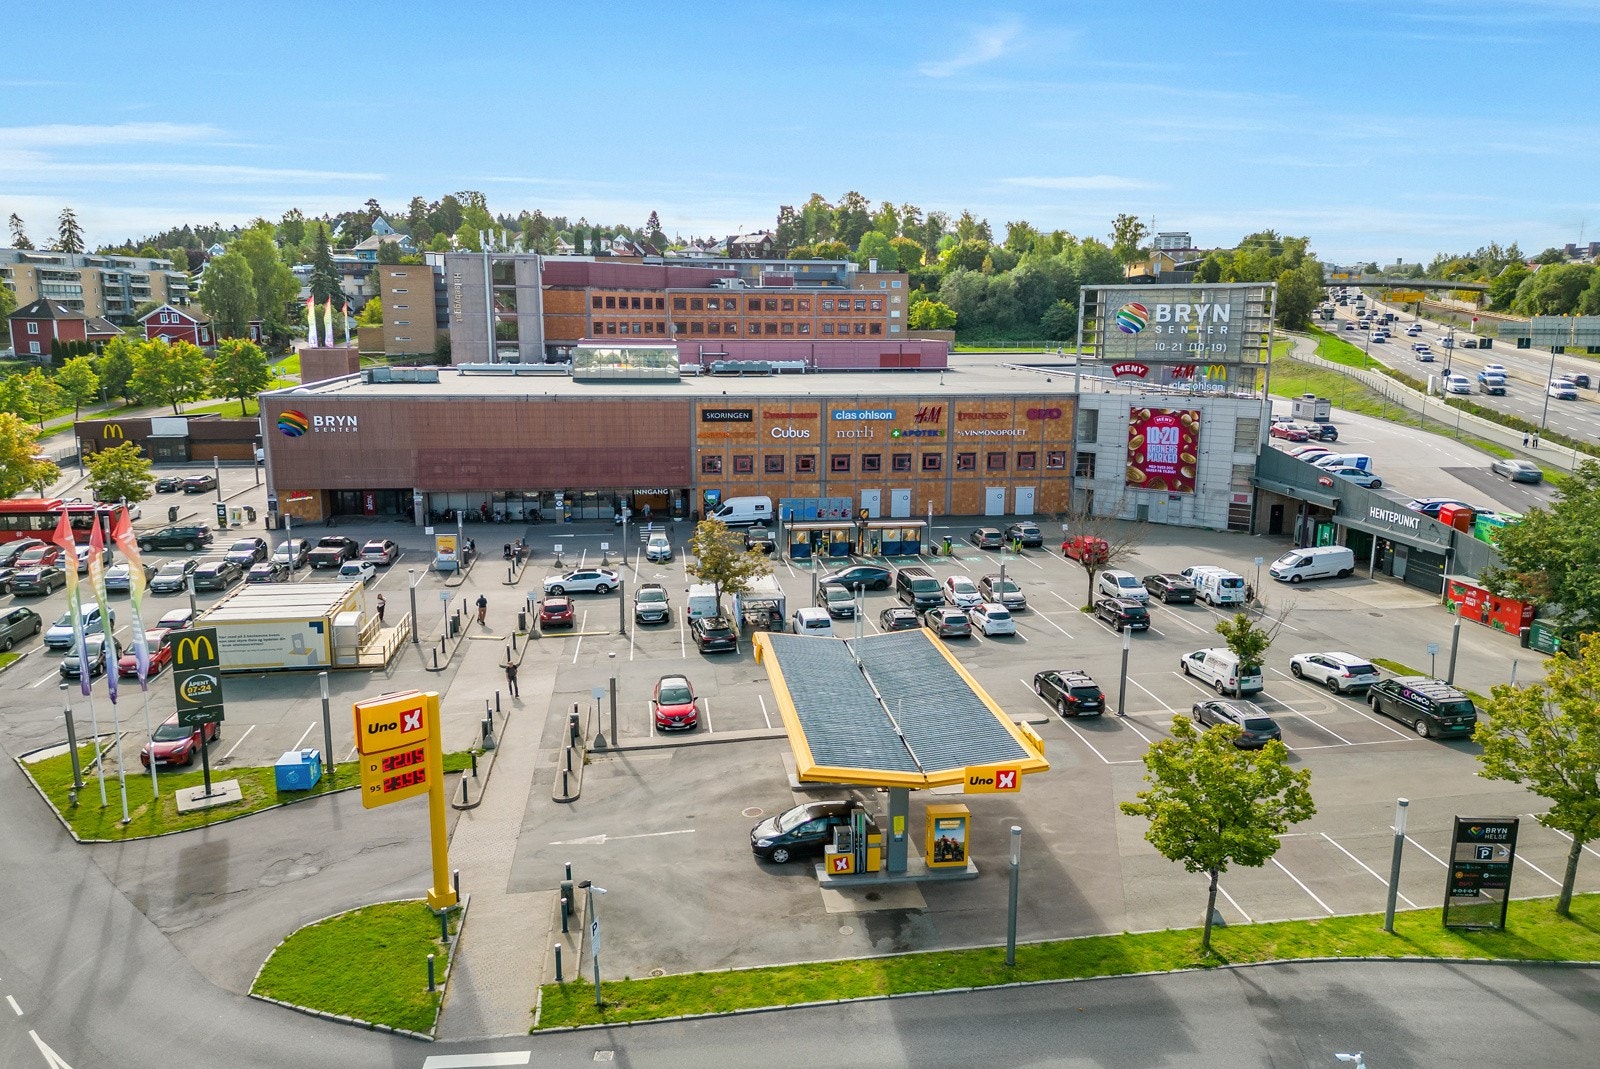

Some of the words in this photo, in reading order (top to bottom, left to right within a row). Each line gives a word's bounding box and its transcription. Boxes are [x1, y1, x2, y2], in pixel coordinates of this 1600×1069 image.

[1156, 304, 1230, 322] BRYN
[1155, 325, 1228, 334] SENTER
[1155, 343, 1182, 351] 10-21
[1189, 343, 1226, 352] (10-19)
[1115, 365, 1145, 374] MENY
[1192, 382, 1223, 391] ohlson
[836, 411, 856, 420] clas
[858, 410, 892, 420] ohlson
[313, 416, 358, 426] BRYN
[771, 426, 810, 438] Cubus
[836, 426, 874, 438] norli
[1147, 452, 1177, 463] MARKED
[1370, 506, 1420, 530] HENTEPUNKT
[187, 685, 211, 693] 07-24
[1411, 693, 1430, 705] OneCo
[368, 722, 398, 734] Uno
[404, 710, 420, 732] X
[969, 777, 993, 786] Uno
[999, 772, 1014, 788] X
[1481, 850, 1489, 858] P
[592, 922, 598, 937] P
